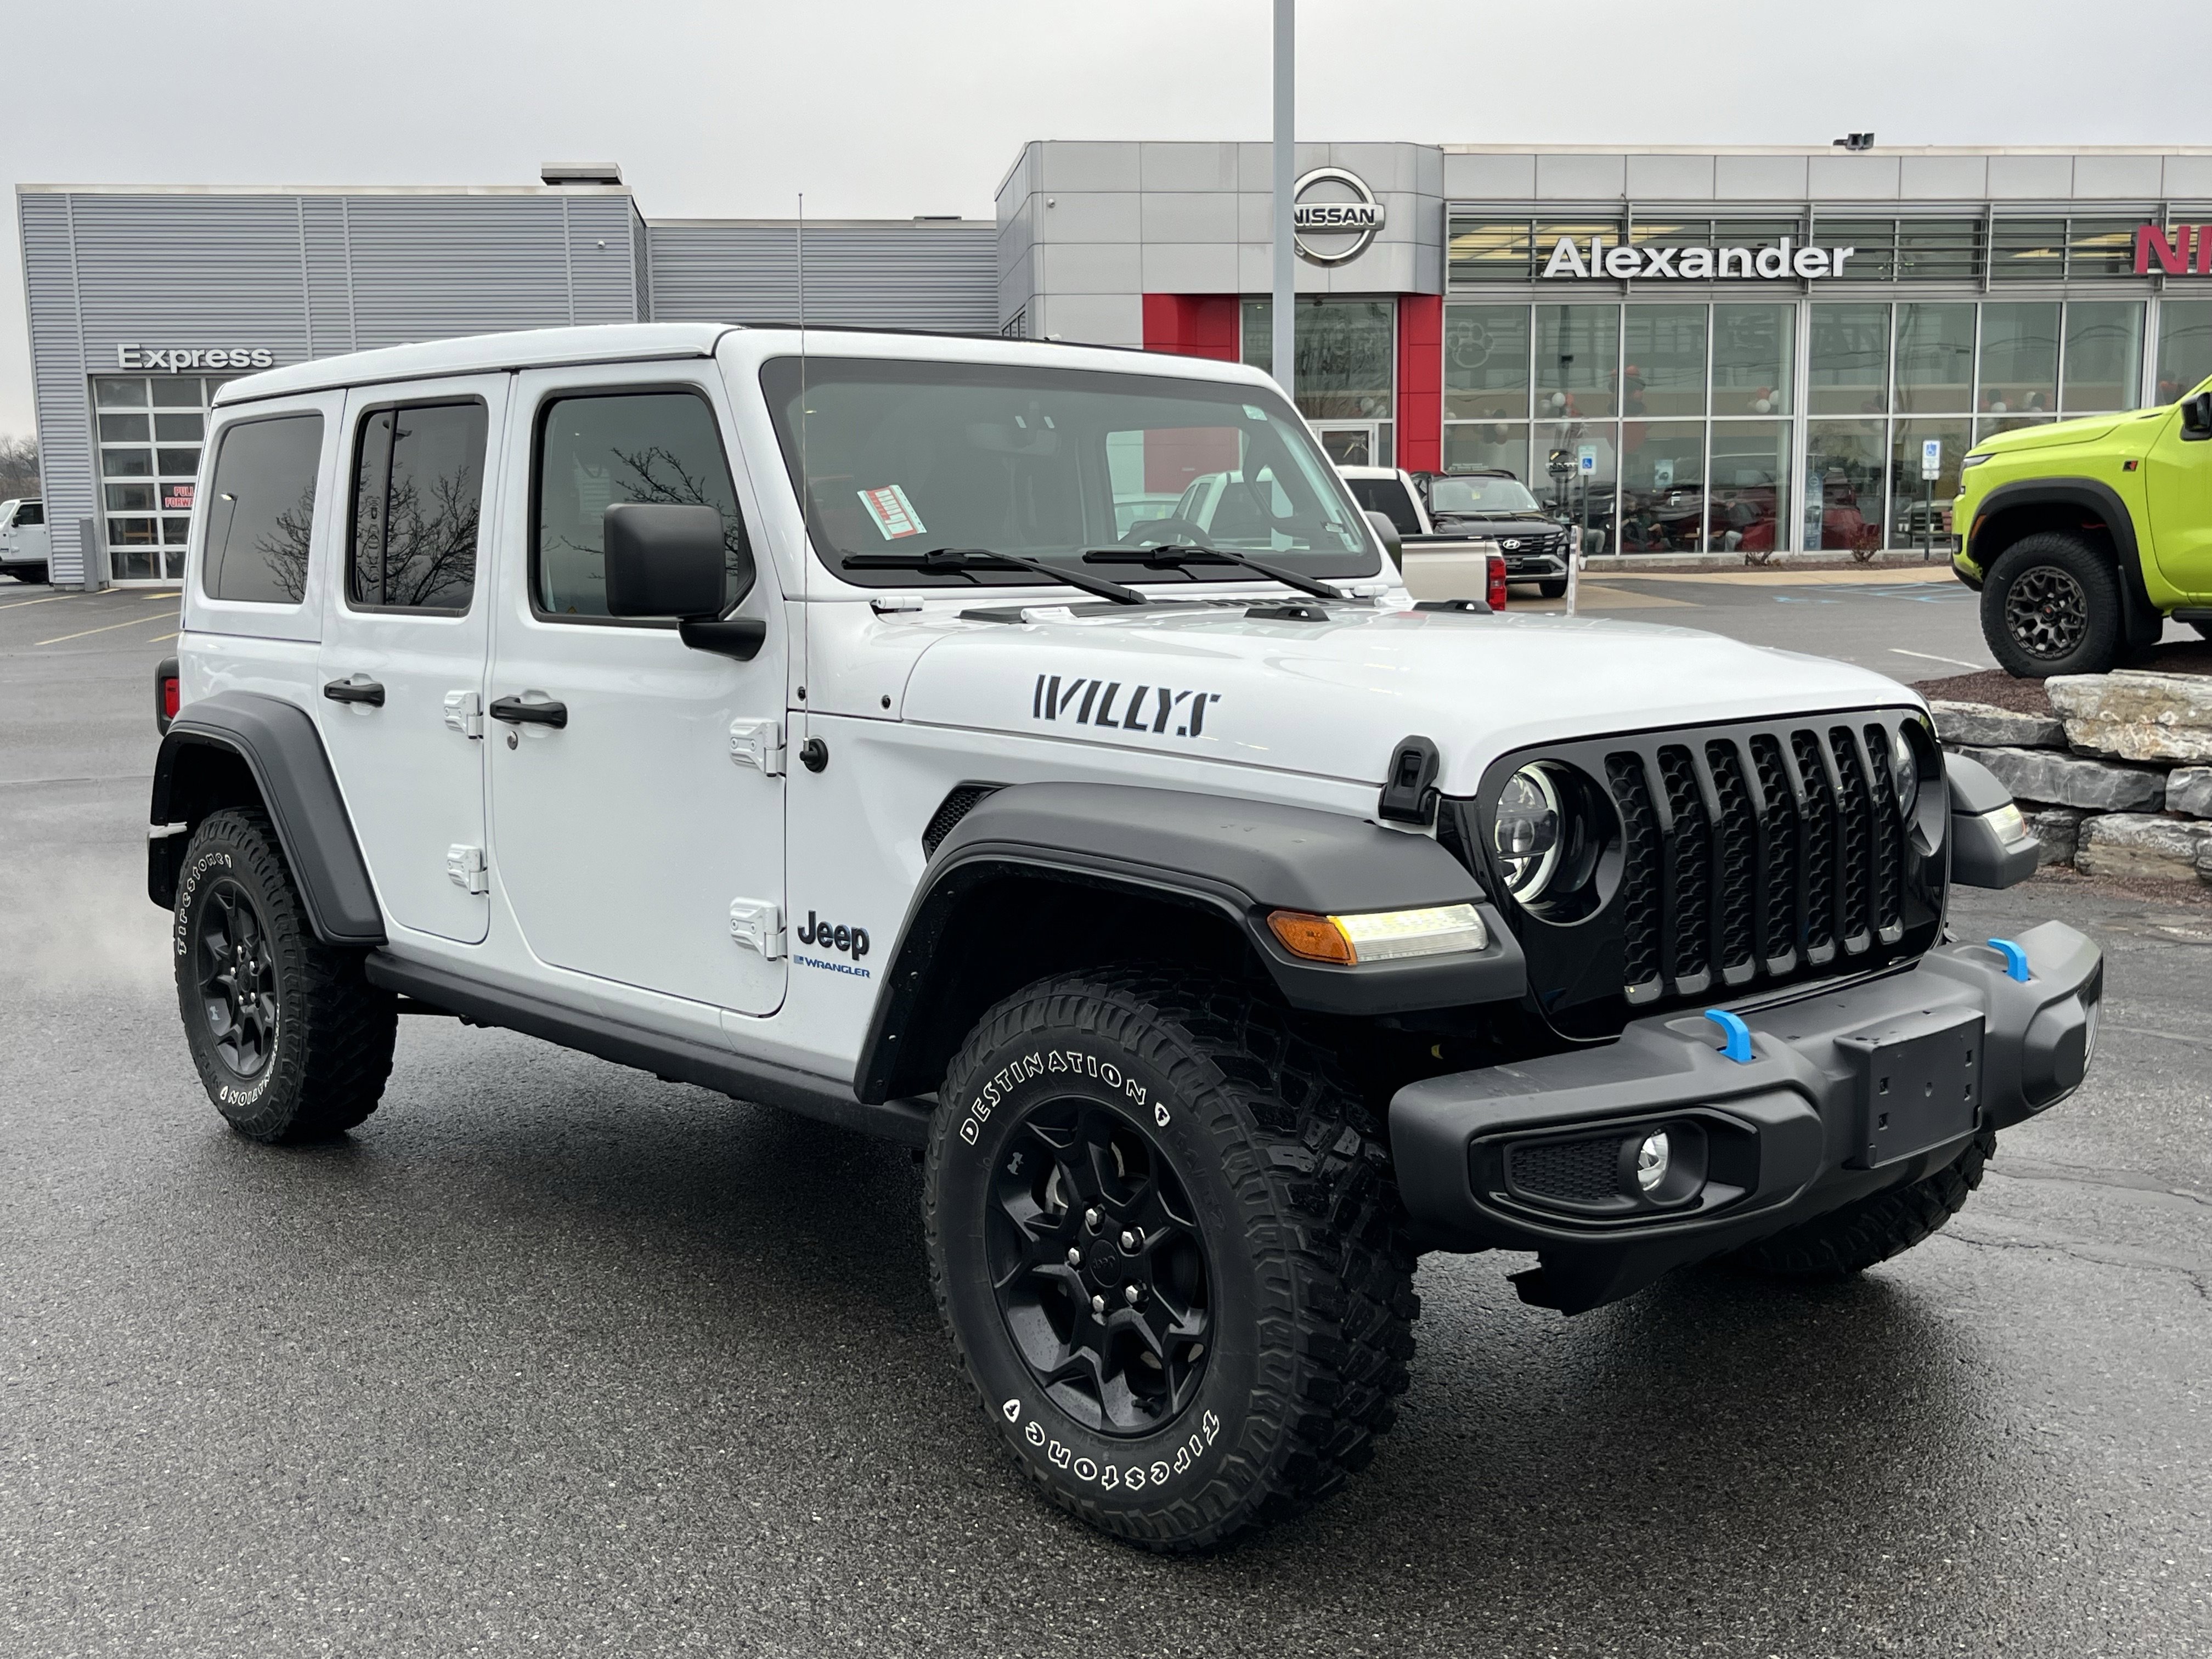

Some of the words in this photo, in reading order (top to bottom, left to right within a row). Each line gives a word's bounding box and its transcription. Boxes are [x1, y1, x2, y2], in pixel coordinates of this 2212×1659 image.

[1542, 236, 1854, 278] Alexander
[2134, 224, 2212, 274] NI
[117, 343, 273, 374] Express
[174, 486, 194, 496] PULL
[1033, 674, 1222, 738] WILLYS
[797, 910, 870, 961] Jeep
[805, 957, 870, 979] WRANGLER
[960, 1049, 1147, 1146] DESTINATION
[1025, 1409, 1220, 1491] Firestone
